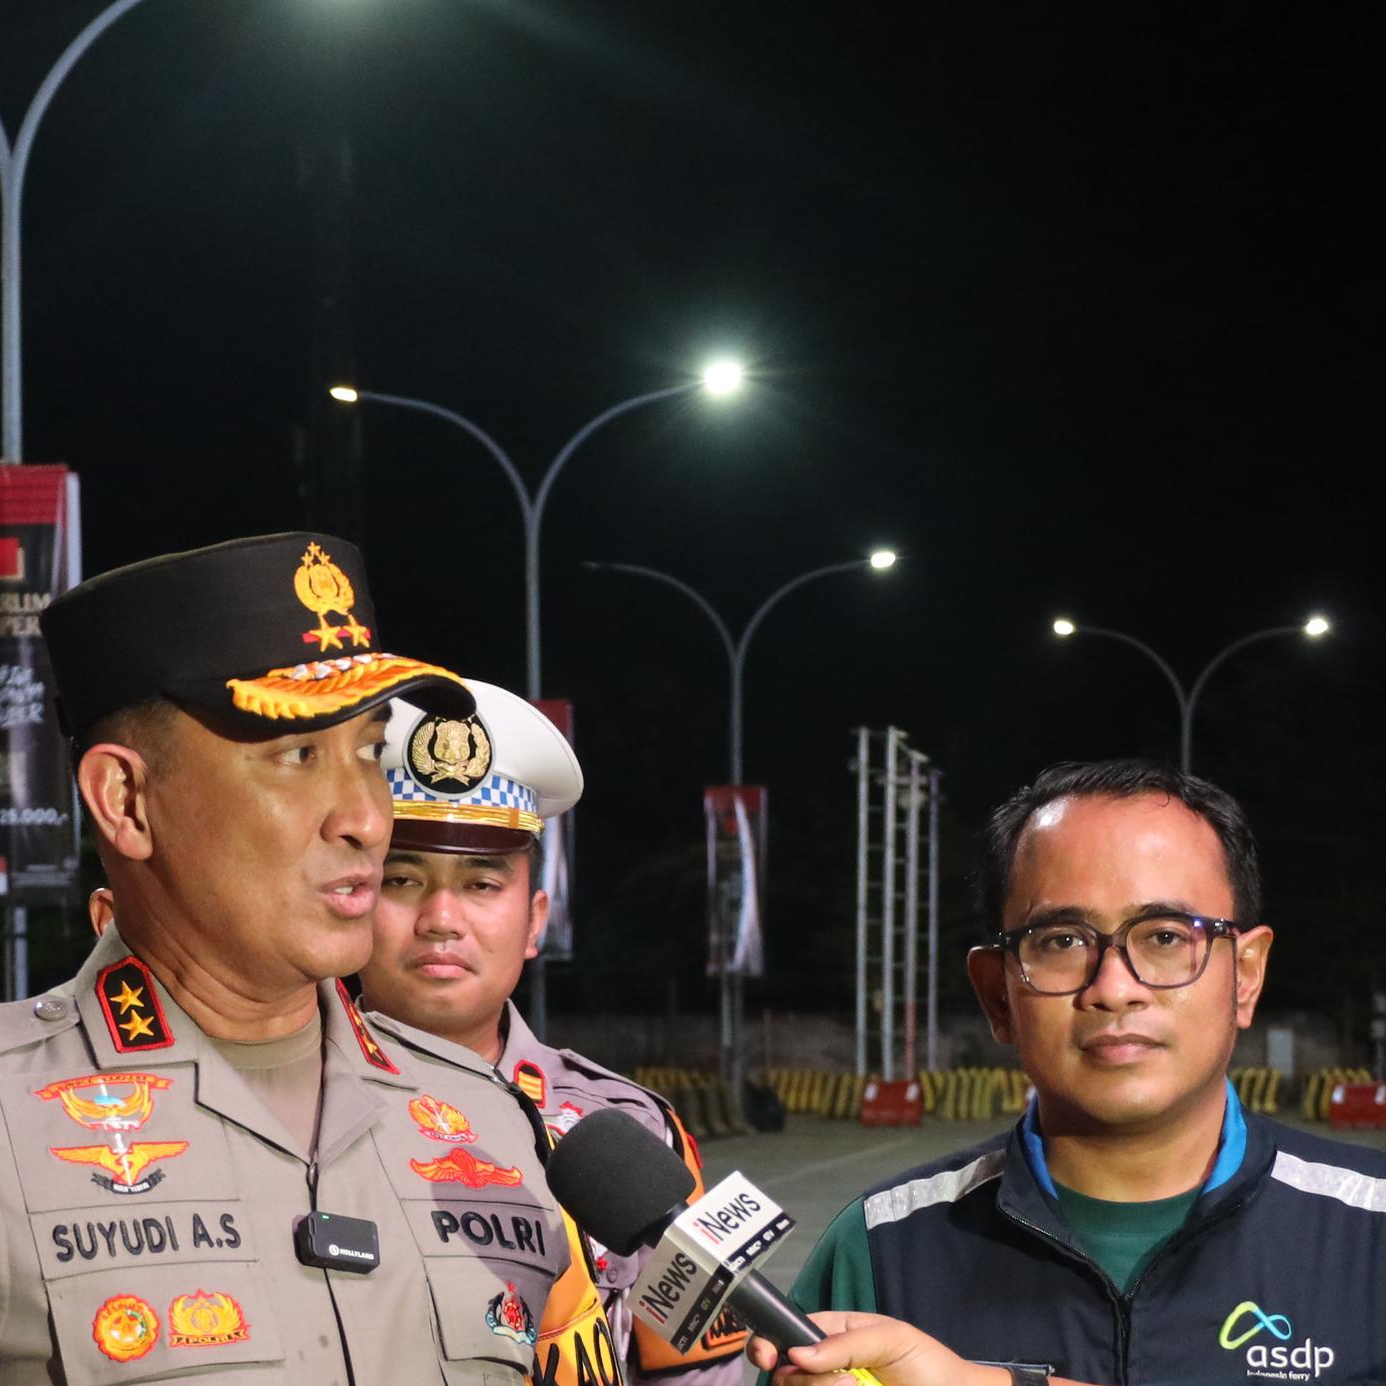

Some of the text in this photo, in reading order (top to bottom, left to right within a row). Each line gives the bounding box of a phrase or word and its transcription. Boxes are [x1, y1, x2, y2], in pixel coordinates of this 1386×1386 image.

[52, 1213, 242, 1263] SUYUDI A.S
[431, 1210, 545, 1257] POLRI
[692, 1193, 762, 1245] iNews
[639, 1252, 697, 1324] iNews
[1246, 1338, 1335, 1378] asdp
[1288, 1371, 1311, 1382] ferry
